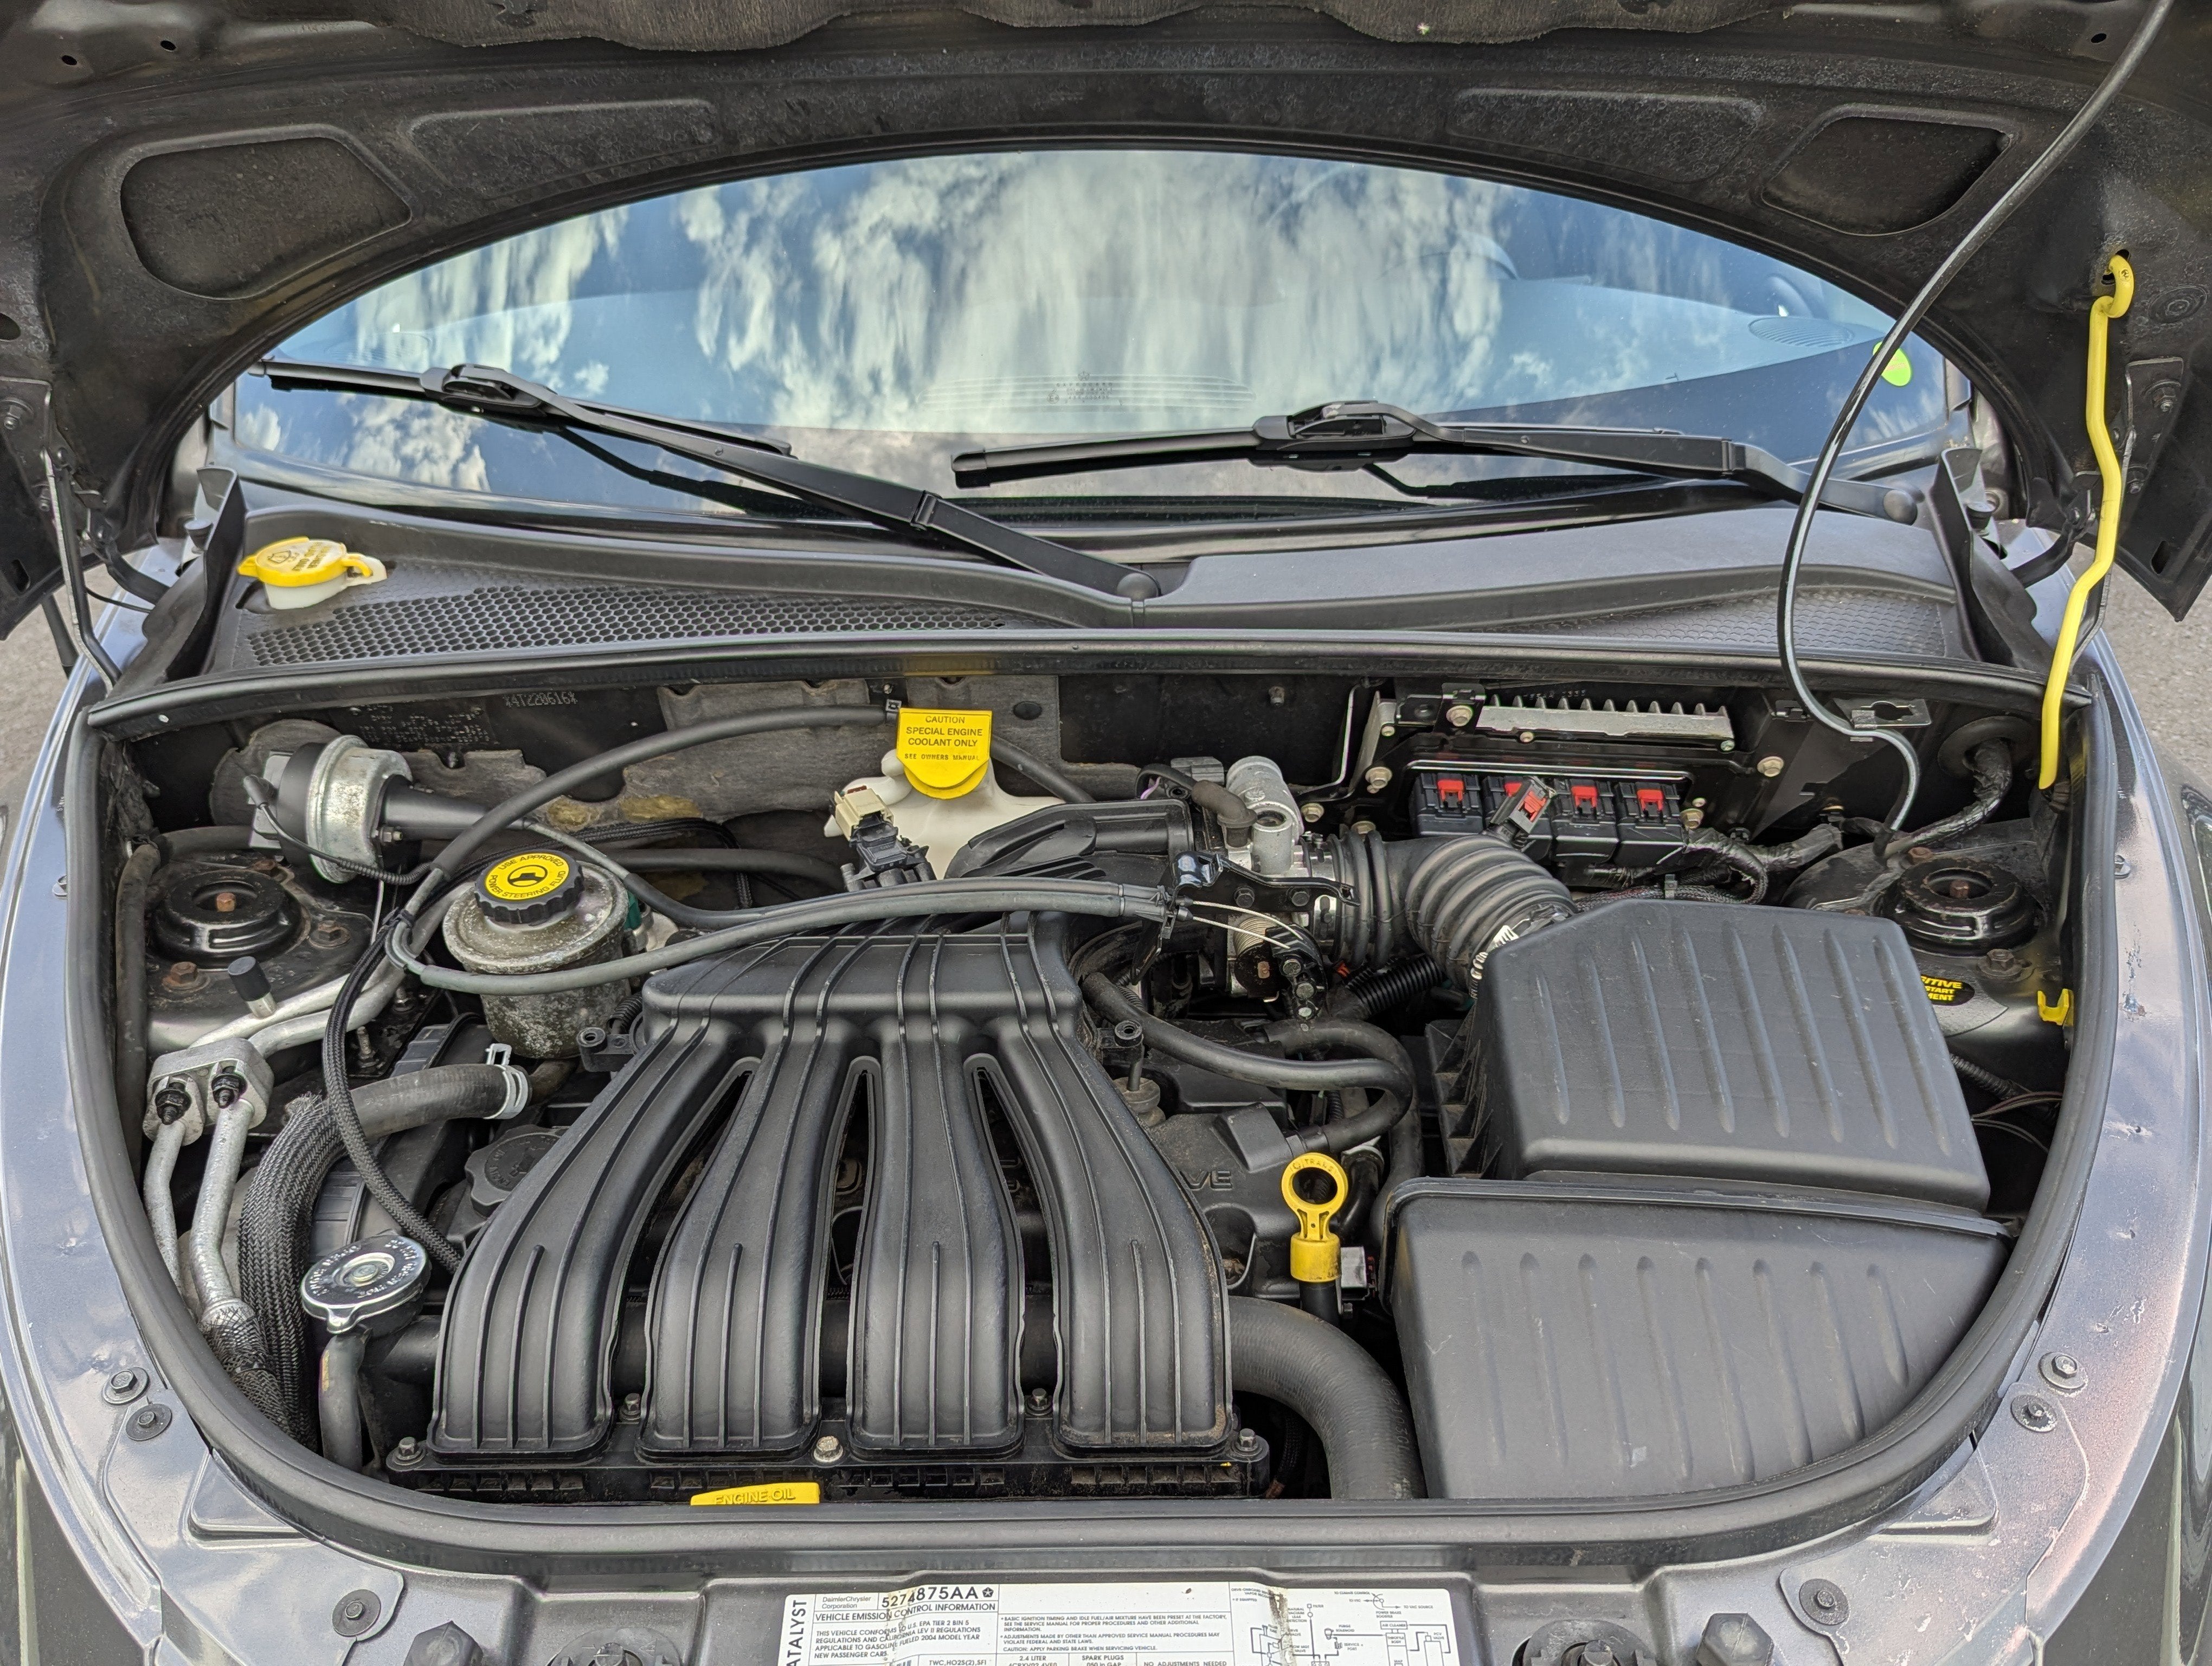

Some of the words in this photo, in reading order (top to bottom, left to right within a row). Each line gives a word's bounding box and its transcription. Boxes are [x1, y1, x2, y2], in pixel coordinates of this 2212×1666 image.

[925, 716, 965, 724] CAUTION
[906, 727, 944, 735] SPECIAL
[947, 728, 982, 736] ENGINE
[908, 738, 952, 746] COOLANT
[954, 739, 978, 747] ONLY
[498, 859, 517, 870] USE
[520, 855, 564, 867] APPROVED
[488, 874, 503, 895] POWER
[502, 886, 550, 898] STEERING
[550, 870, 567, 887] FLUID
[715, 1490, 769, 1505] ENGINE
[771, 1488, 796, 1501] OIL
[882, 1586, 979, 1607] 5274875AA
[815, 1613, 850, 1621] VEHICLE
[852, 1611, 892, 1620] EMISSION
[894, 1604, 933, 1618] CONTROL
[935, 1603, 995, 1611] INFORMATION
[865, 1642, 898, 1650] GASOLINE
[899, 1636, 919, 1646] FUELED
